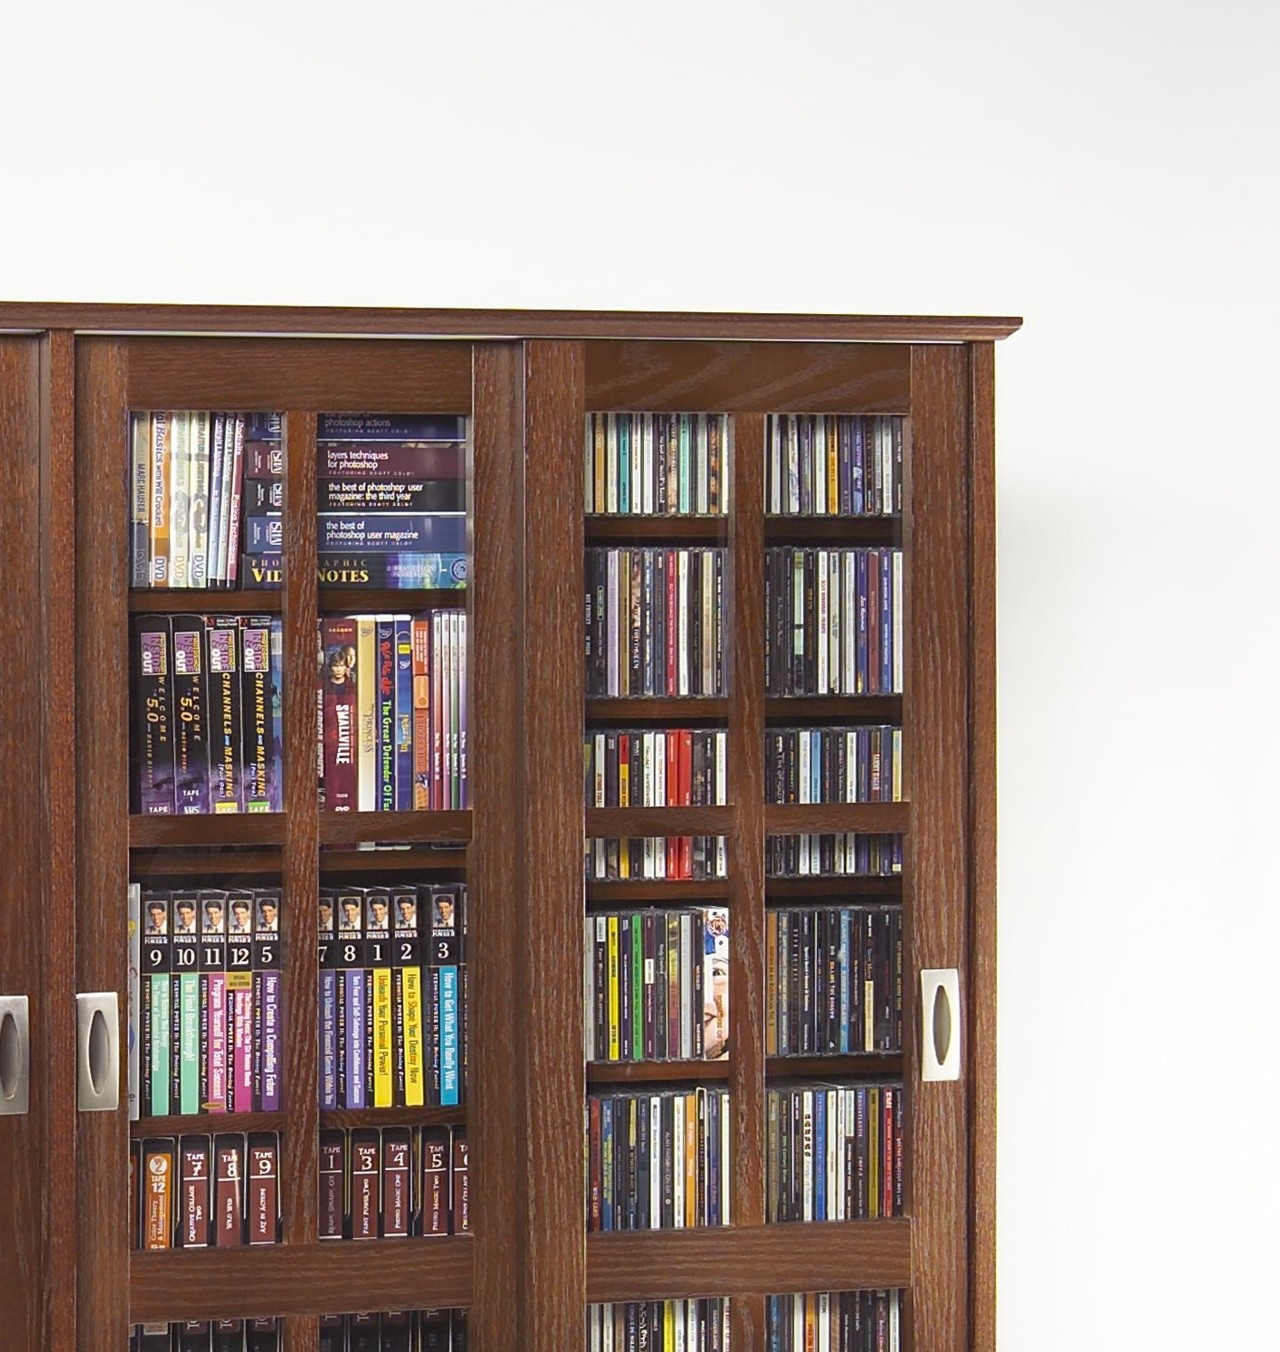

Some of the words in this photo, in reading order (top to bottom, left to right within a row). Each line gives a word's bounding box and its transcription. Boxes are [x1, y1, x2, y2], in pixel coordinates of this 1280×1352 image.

[155, 426, 166, 463] Basics
[327, 450, 348, 461] layers
[349, 450, 389, 461] techniques
[339, 460, 378, 471] photoshop
[329, 483, 340, 491] the
[342, 483, 357, 491] best
[368, 482, 404, 493] photoshop
[378, 492, 395, 500] third
[396, 493, 412, 502] year
[326, 521, 338, 530] the
[340, 521, 355, 530] best
[326, 530, 365, 541] photoshop
[367, 531, 382, 539] user
[384, 529, 418, 541] magazine
[155, 558, 165, 580] DVD
[194, 554, 204, 578] DVD
[143, 652, 152, 675] OUT
[176, 651, 186, 674] OUT
[211, 649, 220, 673] OUT
[245, 648, 254, 672] OUT
[223, 673, 232, 735] CHANNELS
[255, 672, 264, 734] CHANNELS
[382, 700, 392, 715] The
[335, 704, 350, 764] SMALLVILLE
[382, 718, 392, 743] Great
[257, 745, 266, 797] MASKING
[382, 745, 392, 782] Defender
[224, 747, 233, 798] MASKING
[150, 949, 162, 966] 9
[176, 948, 195, 965] 10
[205, 948, 221, 965] 11
[231, 948, 249, 965] 12
[261, 946, 273, 963] 5
[344, 945, 356, 961] 8
[373, 944, 382, 960] 1
[400, 943, 412, 960] 2
[438, 942, 449, 958] 3
[265, 977, 277, 993] How
[407, 973, 417, 990] How
[445, 972, 455, 988] How
[410, 1067, 419, 1083] Now
[255, 1151, 273, 1159] TAPE
[323, 1146, 340, 1154] TAPE
[358, 1147, 376, 1156] TAPE
[429, 1145, 444, 1153] TAPE
[259, 1159, 271, 1175] 9
[329, 1155, 334, 1169] 1
[361, 1156, 372, 1170] 3
[393, 1152, 404, 1166] 4
[432, 1153, 442, 1168] 5
[192, 1161, 202, 1176] 7
[152, 1182, 165, 1193] 12
